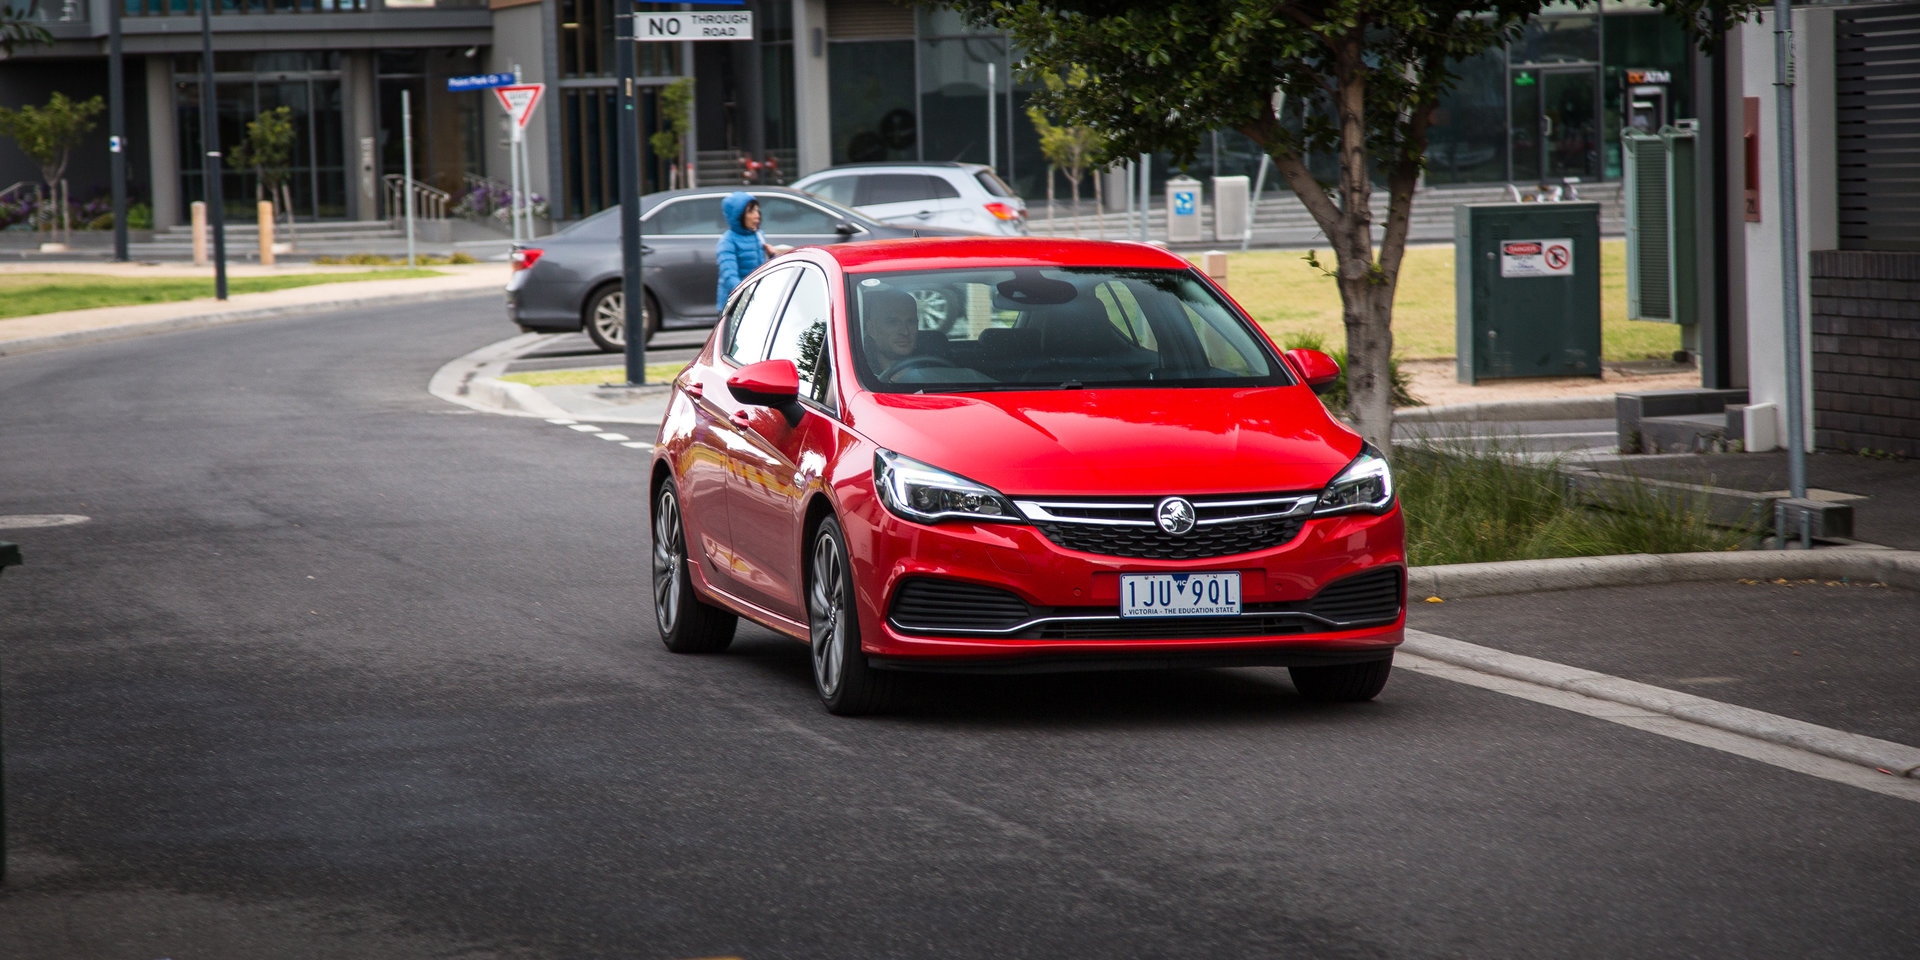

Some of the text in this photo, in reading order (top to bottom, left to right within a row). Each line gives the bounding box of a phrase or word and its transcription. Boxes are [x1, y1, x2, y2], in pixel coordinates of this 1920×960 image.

[691, 15, 748, 24] THROUGH
[649, 18, 681, 36] NO
[703, 27, 737, 36] ROAD
[1129, 579, 1236, 607] 1JU 9QL
